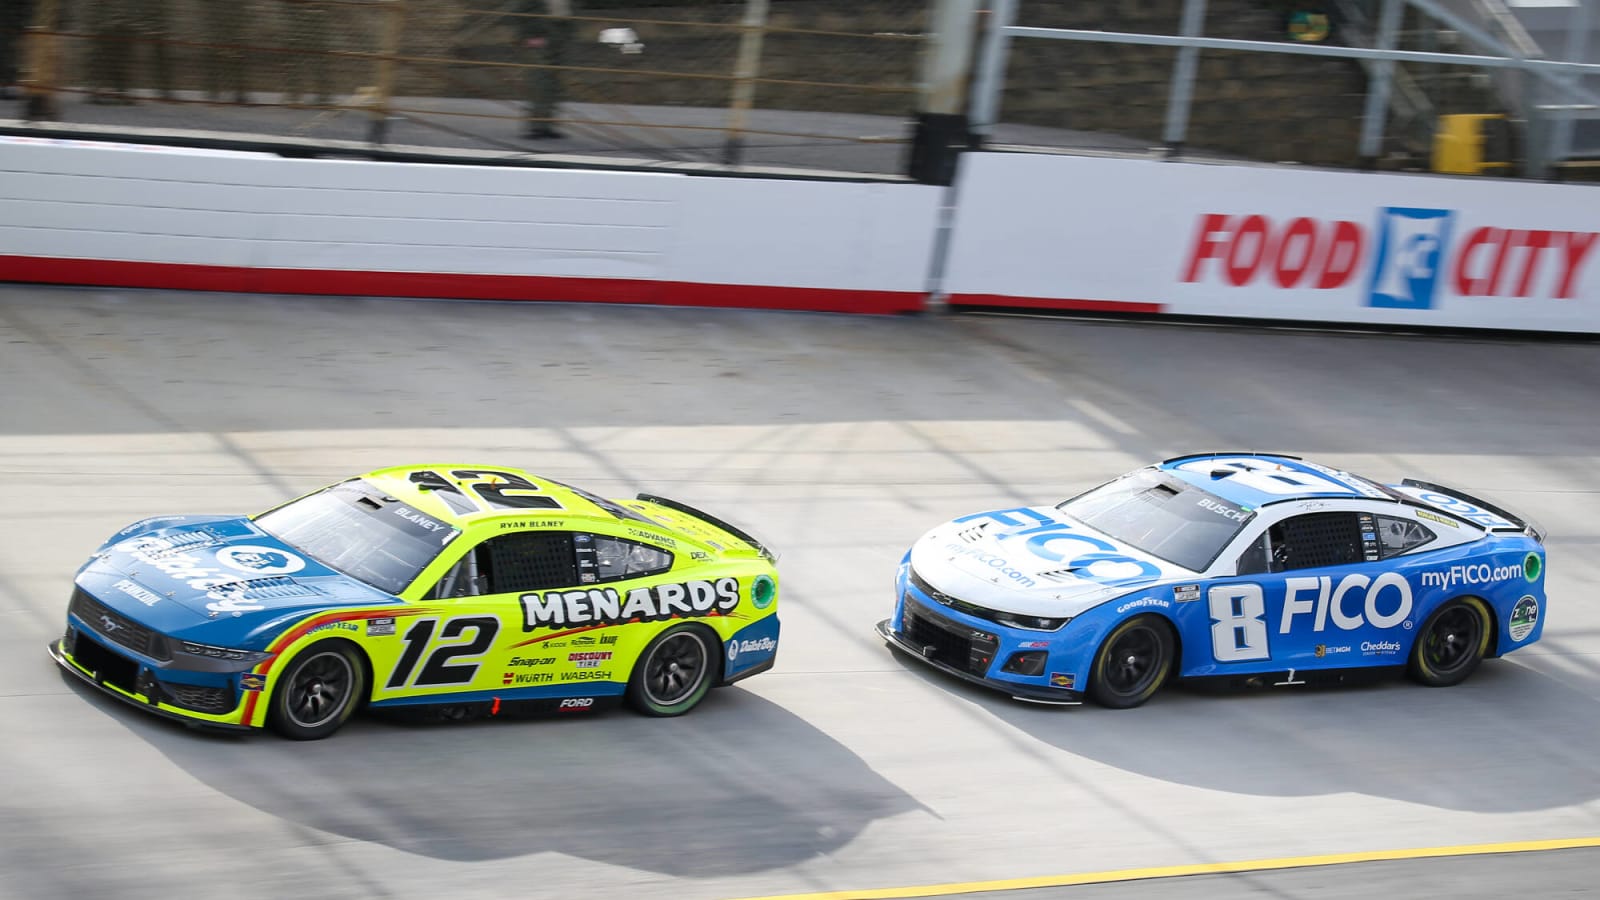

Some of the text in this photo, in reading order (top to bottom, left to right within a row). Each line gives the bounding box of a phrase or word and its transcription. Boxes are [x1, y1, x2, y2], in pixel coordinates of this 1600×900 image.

[1180, 213, 1365, 290] FOOD
[1451, 226, 1599, 299] CITY
[408, 469, 566, 516] 12
[393, 507, 446, 534] BLANEY
[529, 520, 565, 528] BLANEY
[1197, 498, 1248, 526] BUSCH
[638, 530, 676, 547] ADVANCE
[952, 507, 1163, 588] FICO
[1421, 563, 1522, 592] myFICO.com
[521, 577, 741, 630] MENARDS
[1116, 597, 1170, 614] GOODYEAR
[1279, 572, 1413, 635] FICO
[1208, 583, 1271, 664] 8
[386, 614, 502, 690] 12
[568, 652, 613, 661] DISCOUNT
[1360, 641, 1401, 652] Cheddar's
[560, 671, 612, 680] WABASH
[560, 698, 594, 708] FORD
